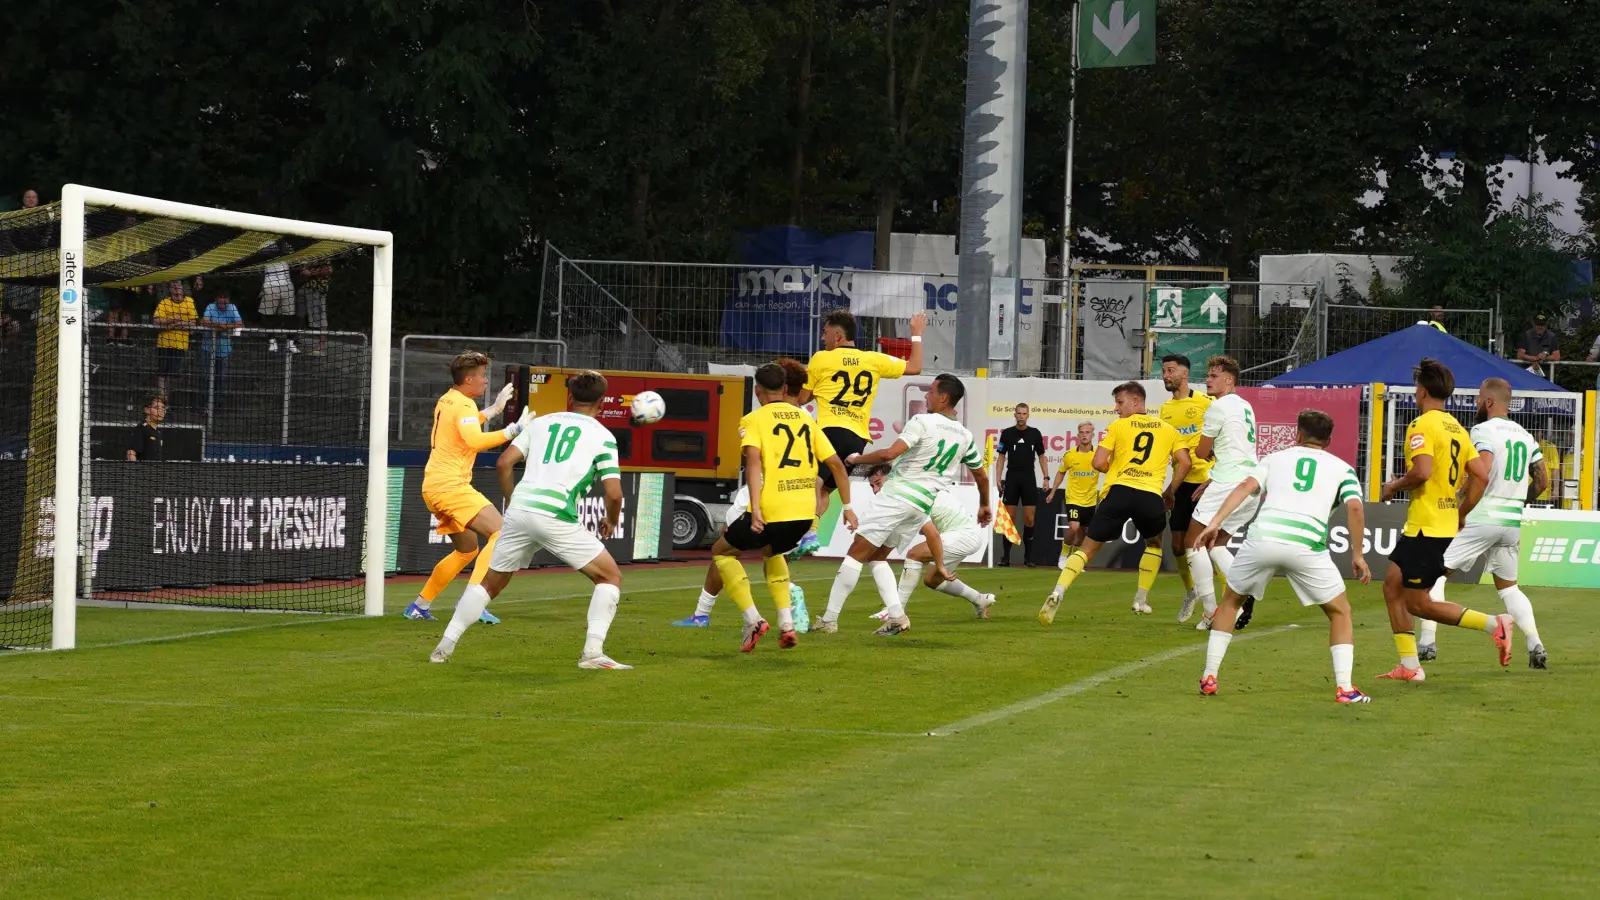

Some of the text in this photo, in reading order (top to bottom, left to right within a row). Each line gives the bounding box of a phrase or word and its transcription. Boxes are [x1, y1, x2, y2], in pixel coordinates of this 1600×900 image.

[65, 252, 77, 286] artec
[531, 373, 546, 384] CAT
[843, 357, 860, 366] GRAF
[829, 370, 873, 407] 29
[772, 411, 801, 420] WEBER
[993, 405, 1003, 413] Für
[542, 423, 581, 464] 18
[772, 423, 814, 469] 21
[923, 439, 959, 476] 14
[1129, 431, 1154, 466] 9
[1504, 439, 1527, 483] 10
[1293, 457, 1317, 492] 9
[1448, 438, 1461, 487] 8
[153, 496, 214, 554] ENJOY
[220, 497, 253, 552] THE
[259, 496, 346, 550] PRESSURE
[1068, 508, 1079, 519] 16
